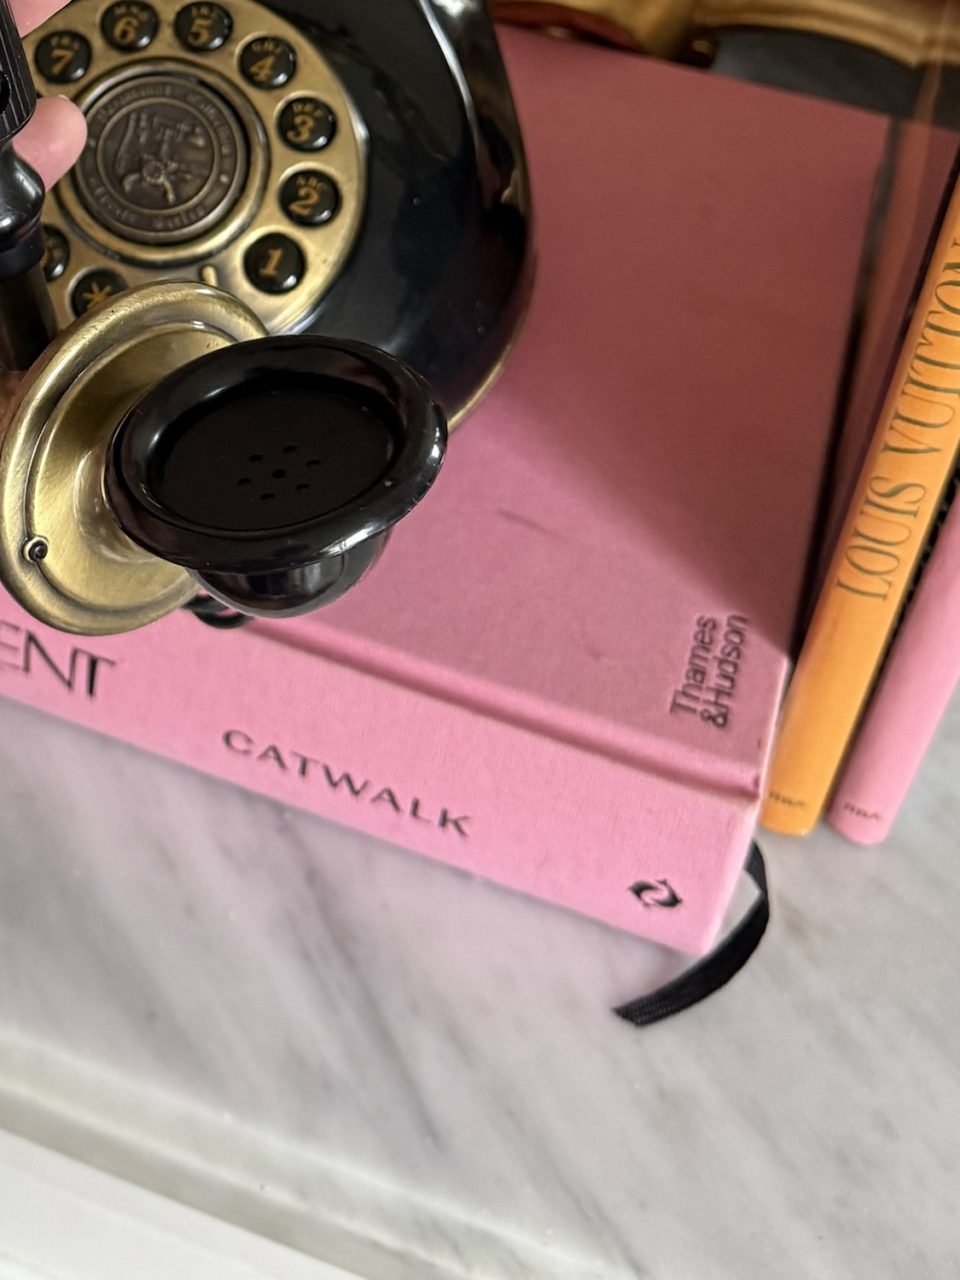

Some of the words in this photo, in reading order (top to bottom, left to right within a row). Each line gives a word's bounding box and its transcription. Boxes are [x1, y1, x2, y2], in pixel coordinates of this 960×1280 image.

[113, 16, 139, 45] 6
[187, 18, 212, 46] 5
[50, 48, 76, 76] 7
[248, 55, 276, 82] 4
[286, 114, 315, 144] 3
[288, 186, 319, 216] 2
[259, 248, 283, 277] 1
[881, 237, 960, 455] VUITT
[836, 475, 927, 601] LOUIS
[669, 616, 717, 715] Thames
[700, 615, 749, 729] &Hudson
[221, 729, 472, 838] CATWALK
